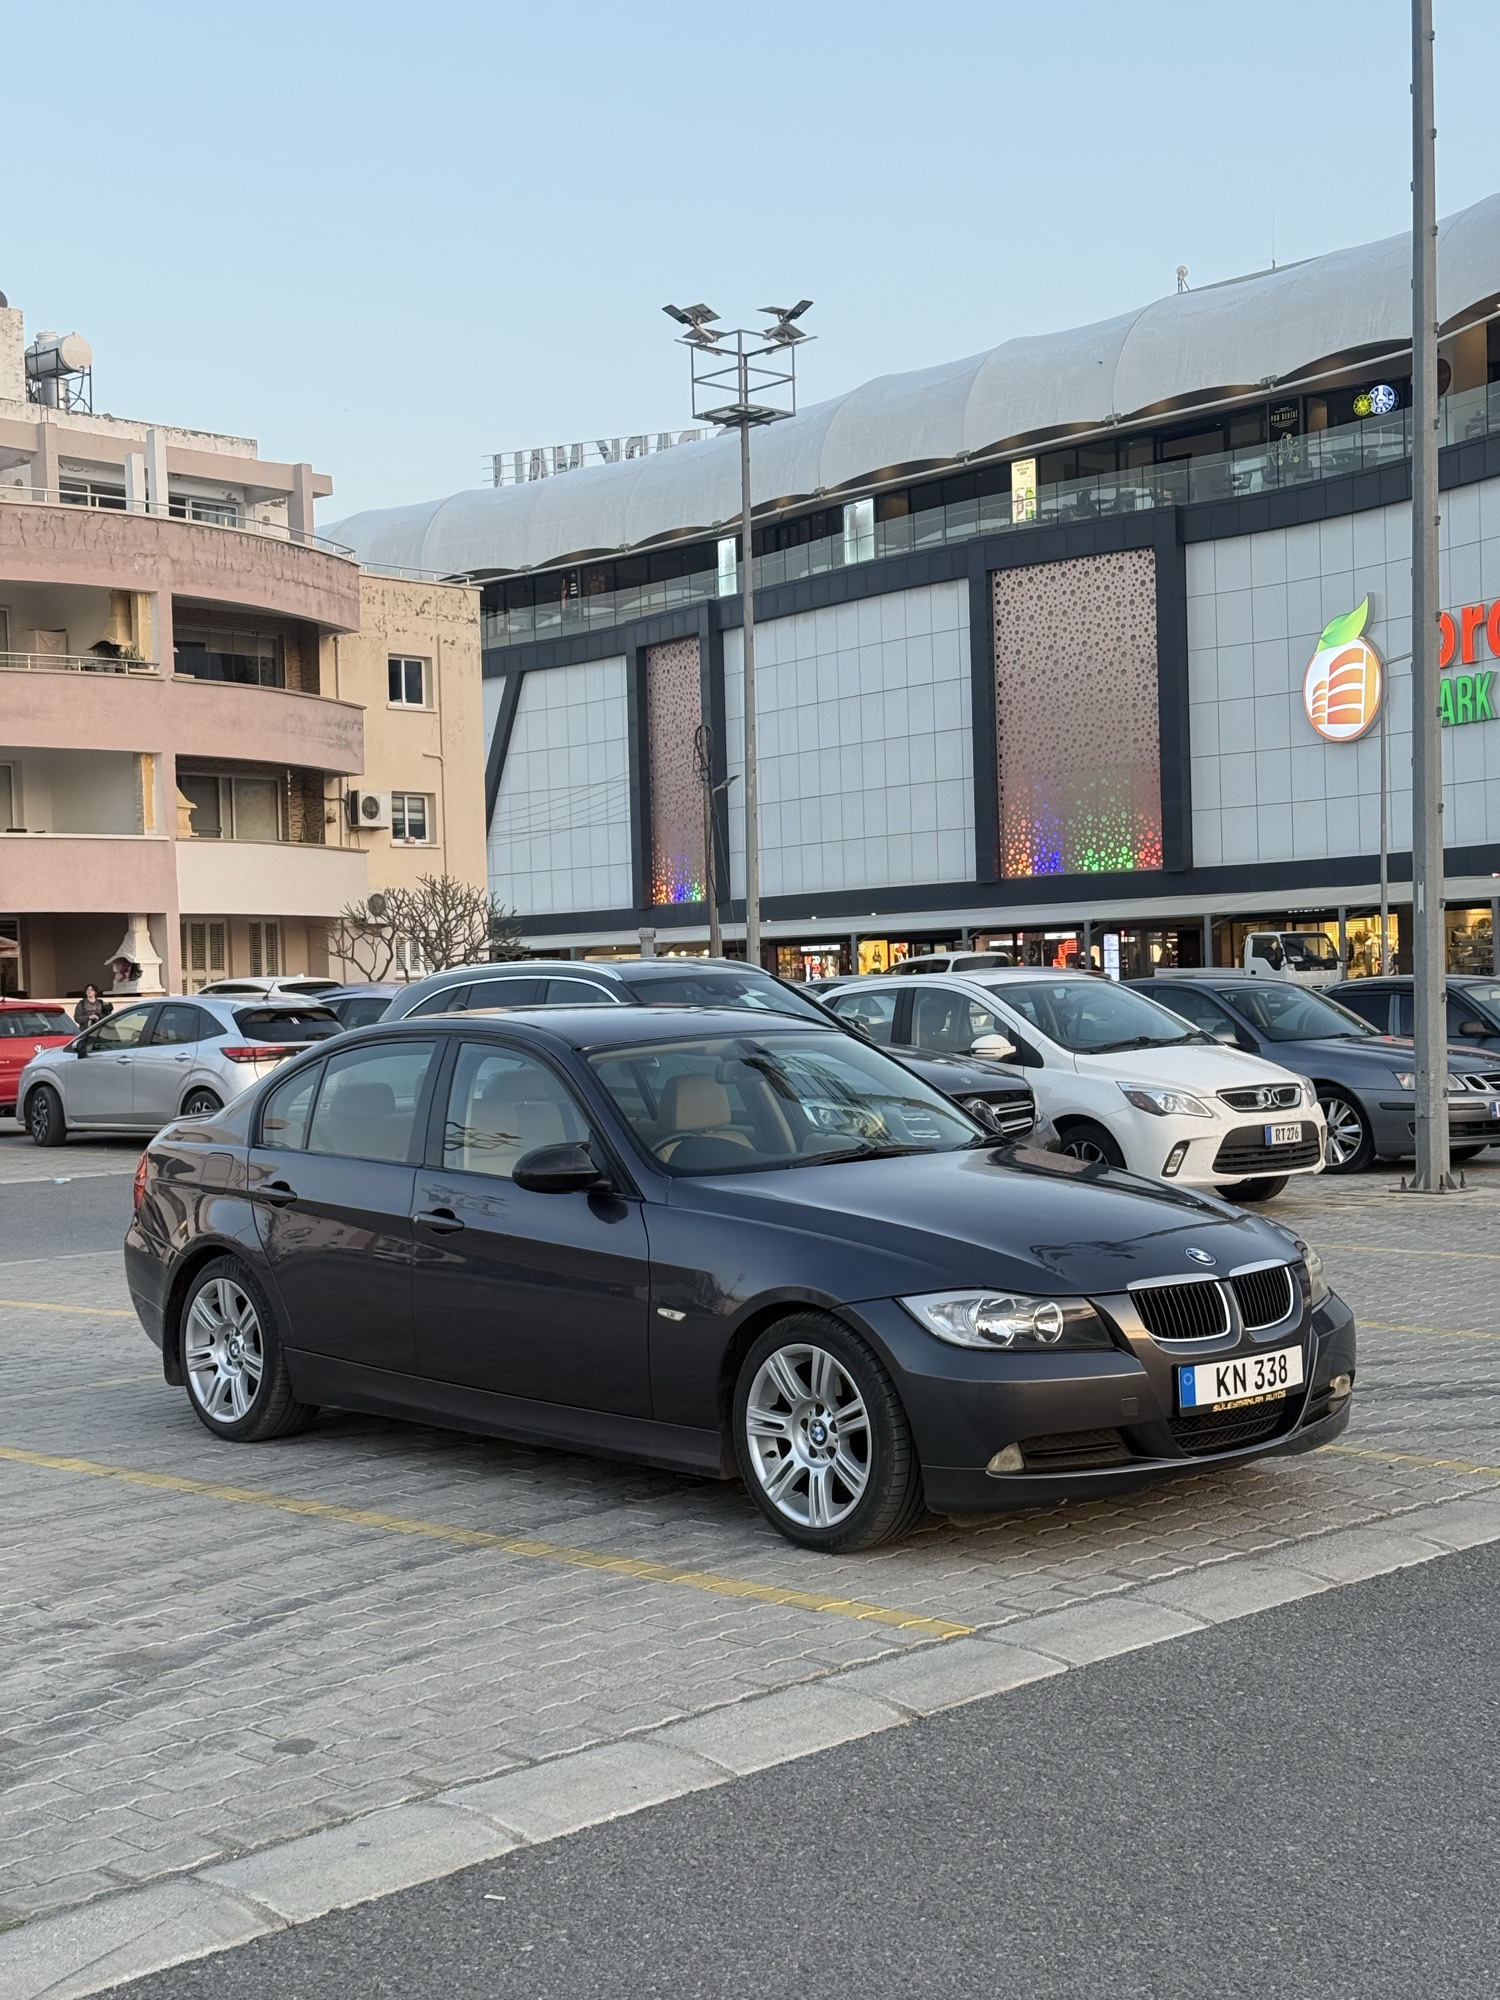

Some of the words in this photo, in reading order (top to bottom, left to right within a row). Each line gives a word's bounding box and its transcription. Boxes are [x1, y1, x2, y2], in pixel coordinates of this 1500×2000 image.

[1440, 671, 1493, 727] ARK
[1275, 1128, 1286, 1141] RT
[1287, 1126, 1300, 1141] 276
[1216, 1362, 1247, 1398] KN
[1254, 1354, 1288, 1390] 338
